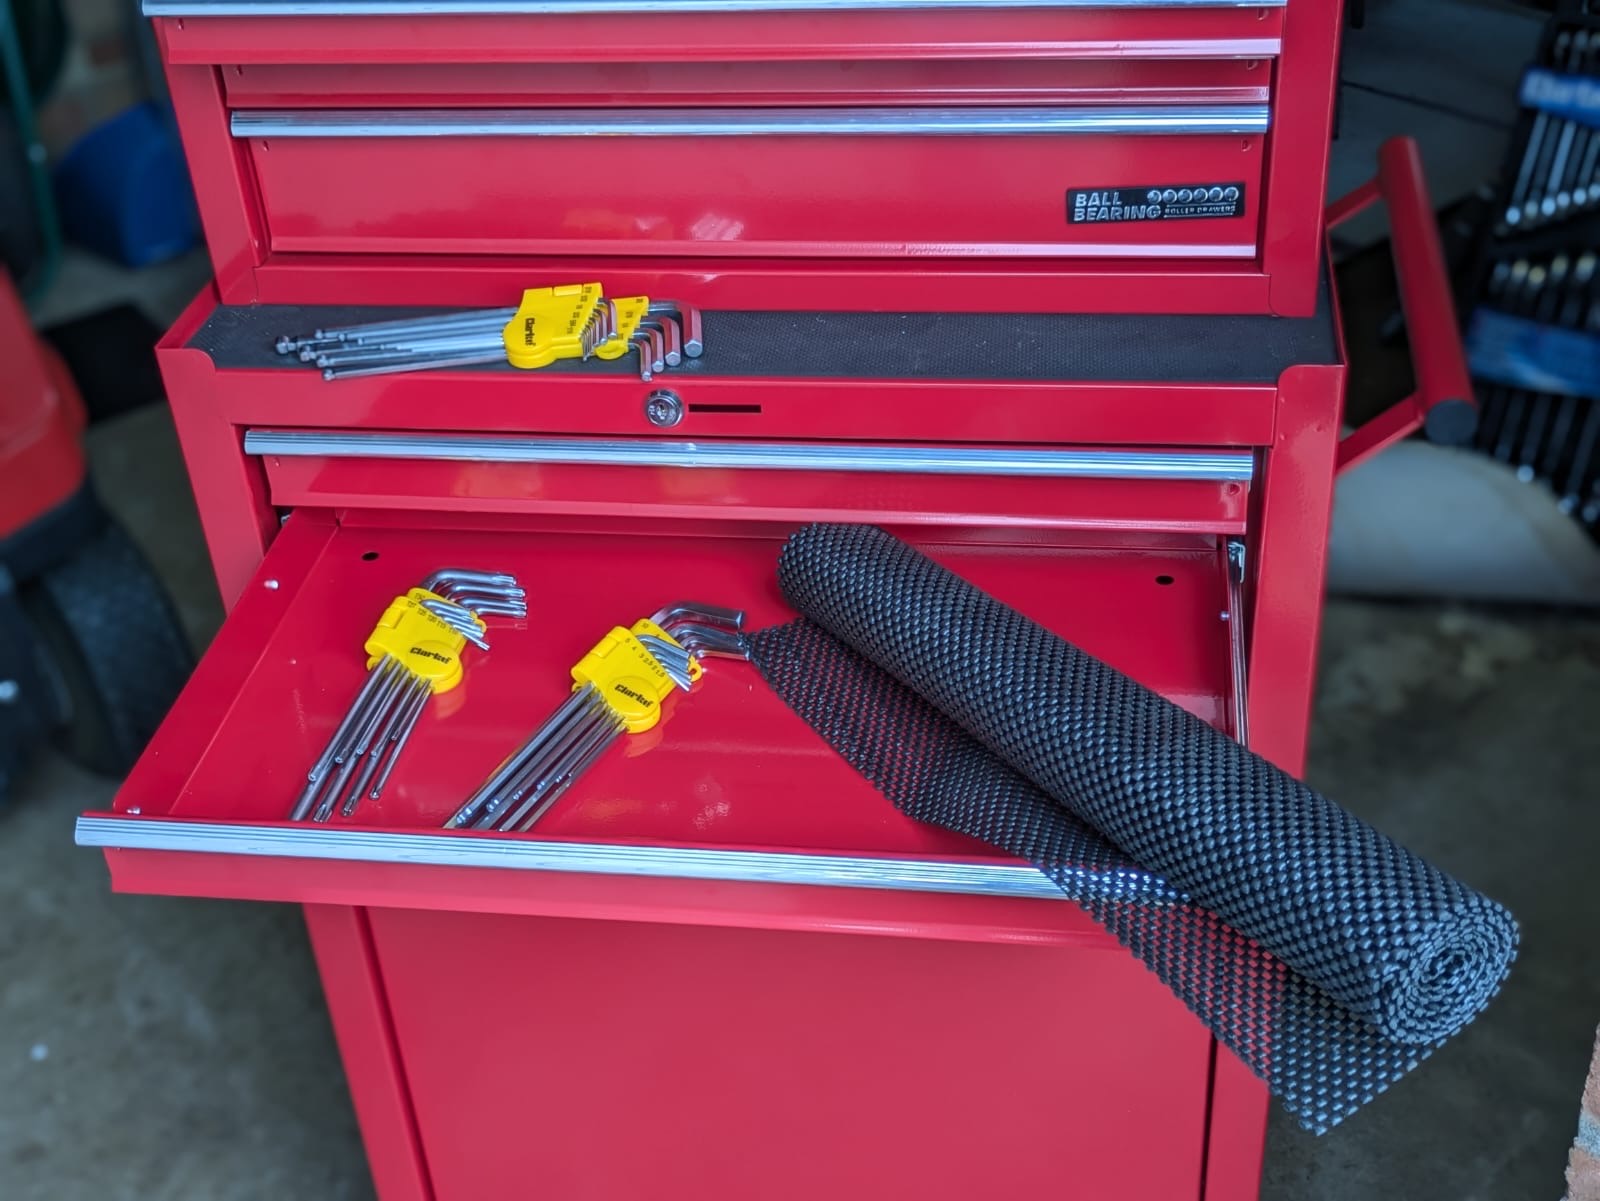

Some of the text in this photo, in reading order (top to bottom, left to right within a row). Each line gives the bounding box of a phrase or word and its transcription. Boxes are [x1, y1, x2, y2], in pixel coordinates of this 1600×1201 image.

[1075, 191, 1123, 207] BALL
[1073, 204, 1161, 222] BEARING
[1164, 204, 1236, 215] ROLLER DRAWERS
[410, 647, 452, 664] Clarke
[614, 684, 653, 708] Clarke
